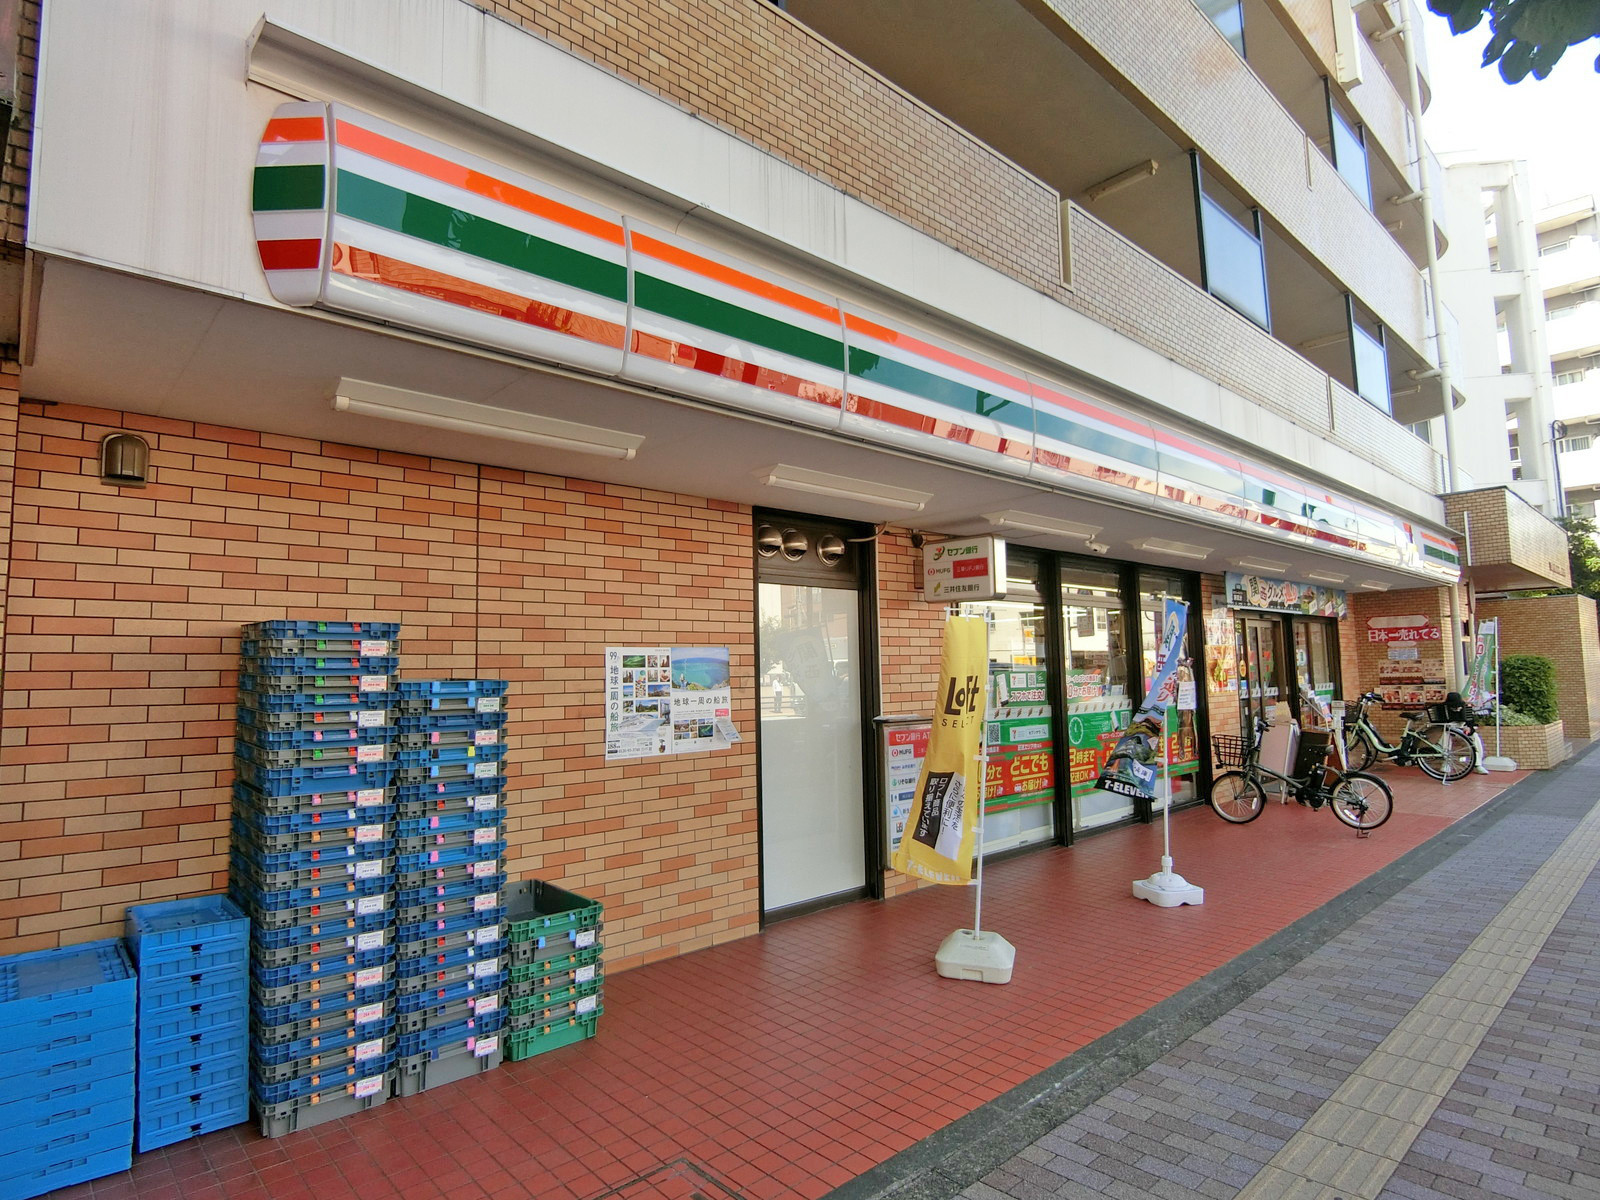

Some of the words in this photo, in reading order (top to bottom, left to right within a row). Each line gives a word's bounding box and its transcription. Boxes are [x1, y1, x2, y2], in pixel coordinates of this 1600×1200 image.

[947, 545, 978, 556] セブン銀行
[943, 584, 980, 593] 三井住友銀行
[1368, 628, 1440, 642] 日本一売れてる
[609, 665, 620, 732] 地球一周の船旅
[673, 696, 729, 706] 地球一周の船旅
[1010, 689, 1045, 701] スマホで注文!
[895, 732, 921, 742] セブン銀行
[922, 731, 931, 740] AT
[1010, 753, 1049, 775] どこでも
[1021, 778, 1042, 792] お届け!
[931, 777, 949, 817] ロフト商品
